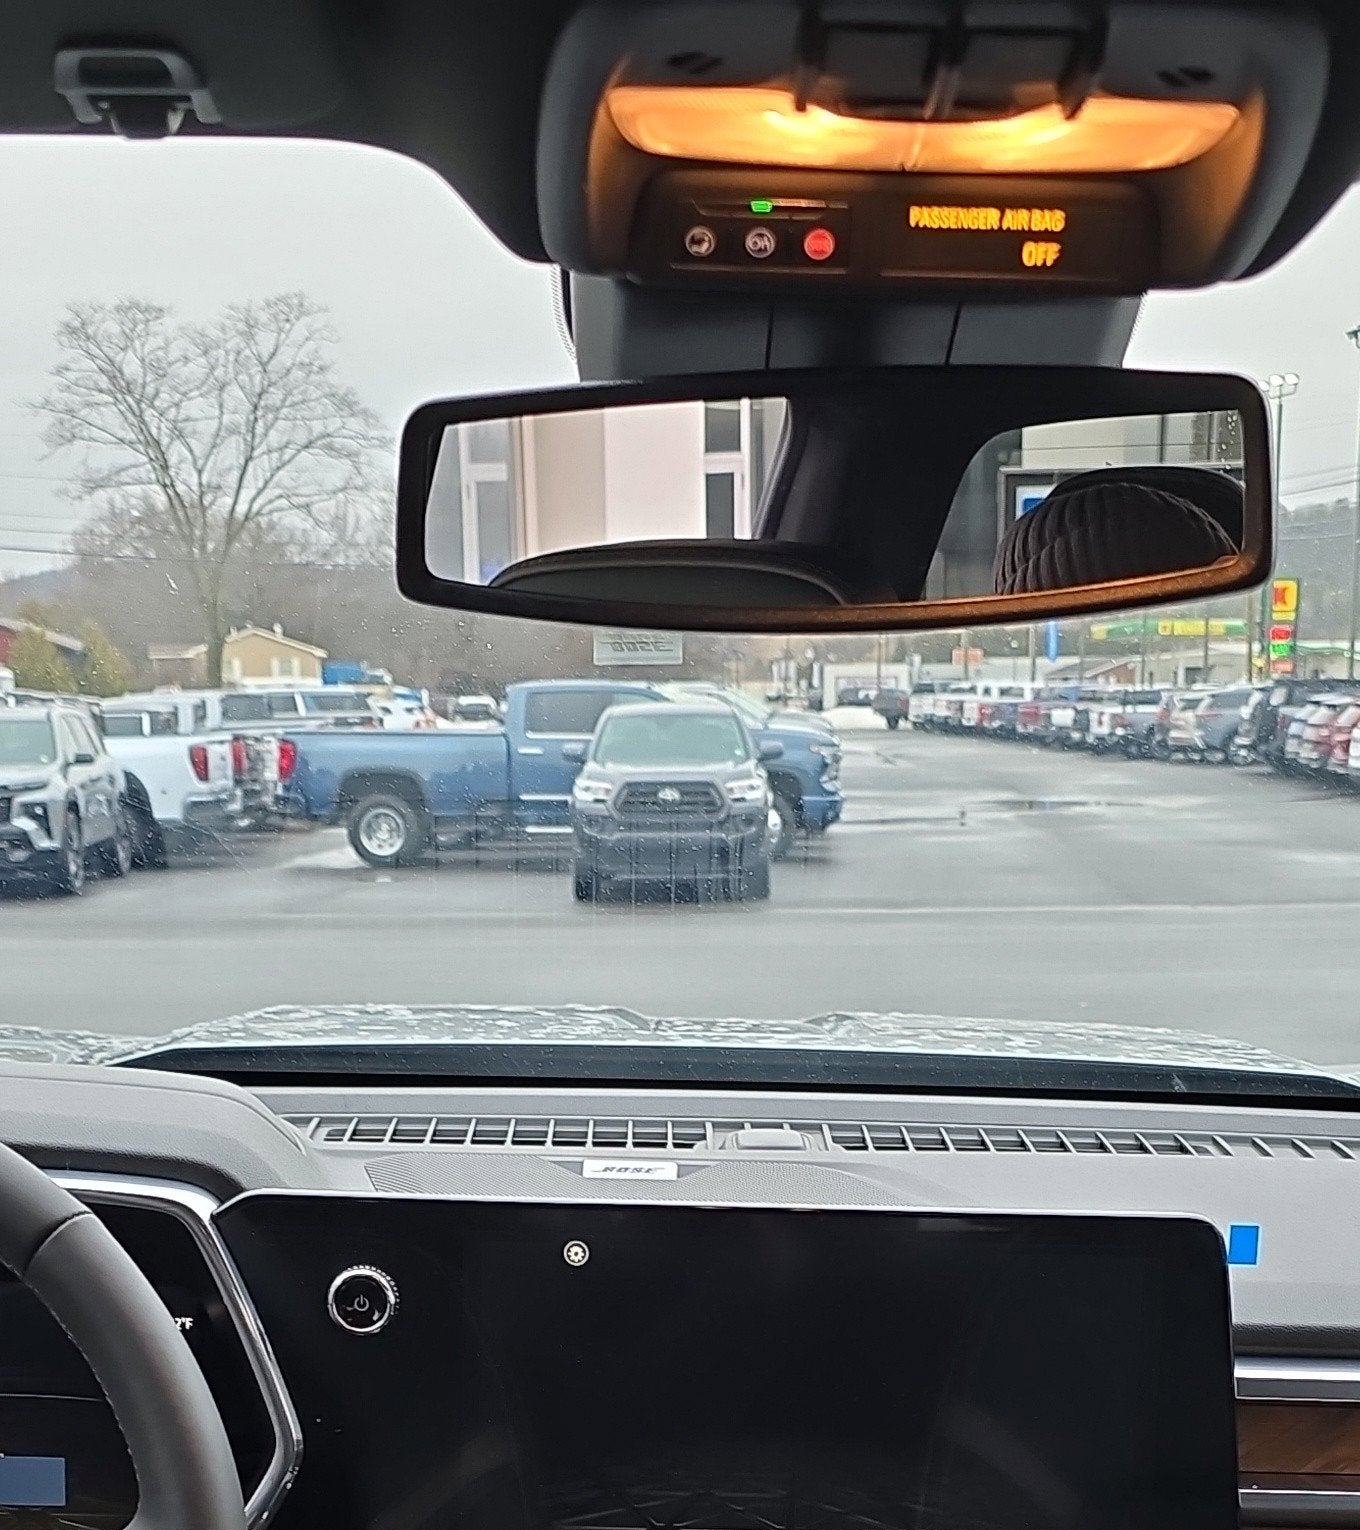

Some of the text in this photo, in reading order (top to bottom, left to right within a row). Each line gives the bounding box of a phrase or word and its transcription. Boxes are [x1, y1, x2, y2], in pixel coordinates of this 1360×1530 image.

[909, 206, 999, 231] PASSENGER
[1030, 209, 1066, 232] BAG
[1022, 242, 1061, 267] OFF
